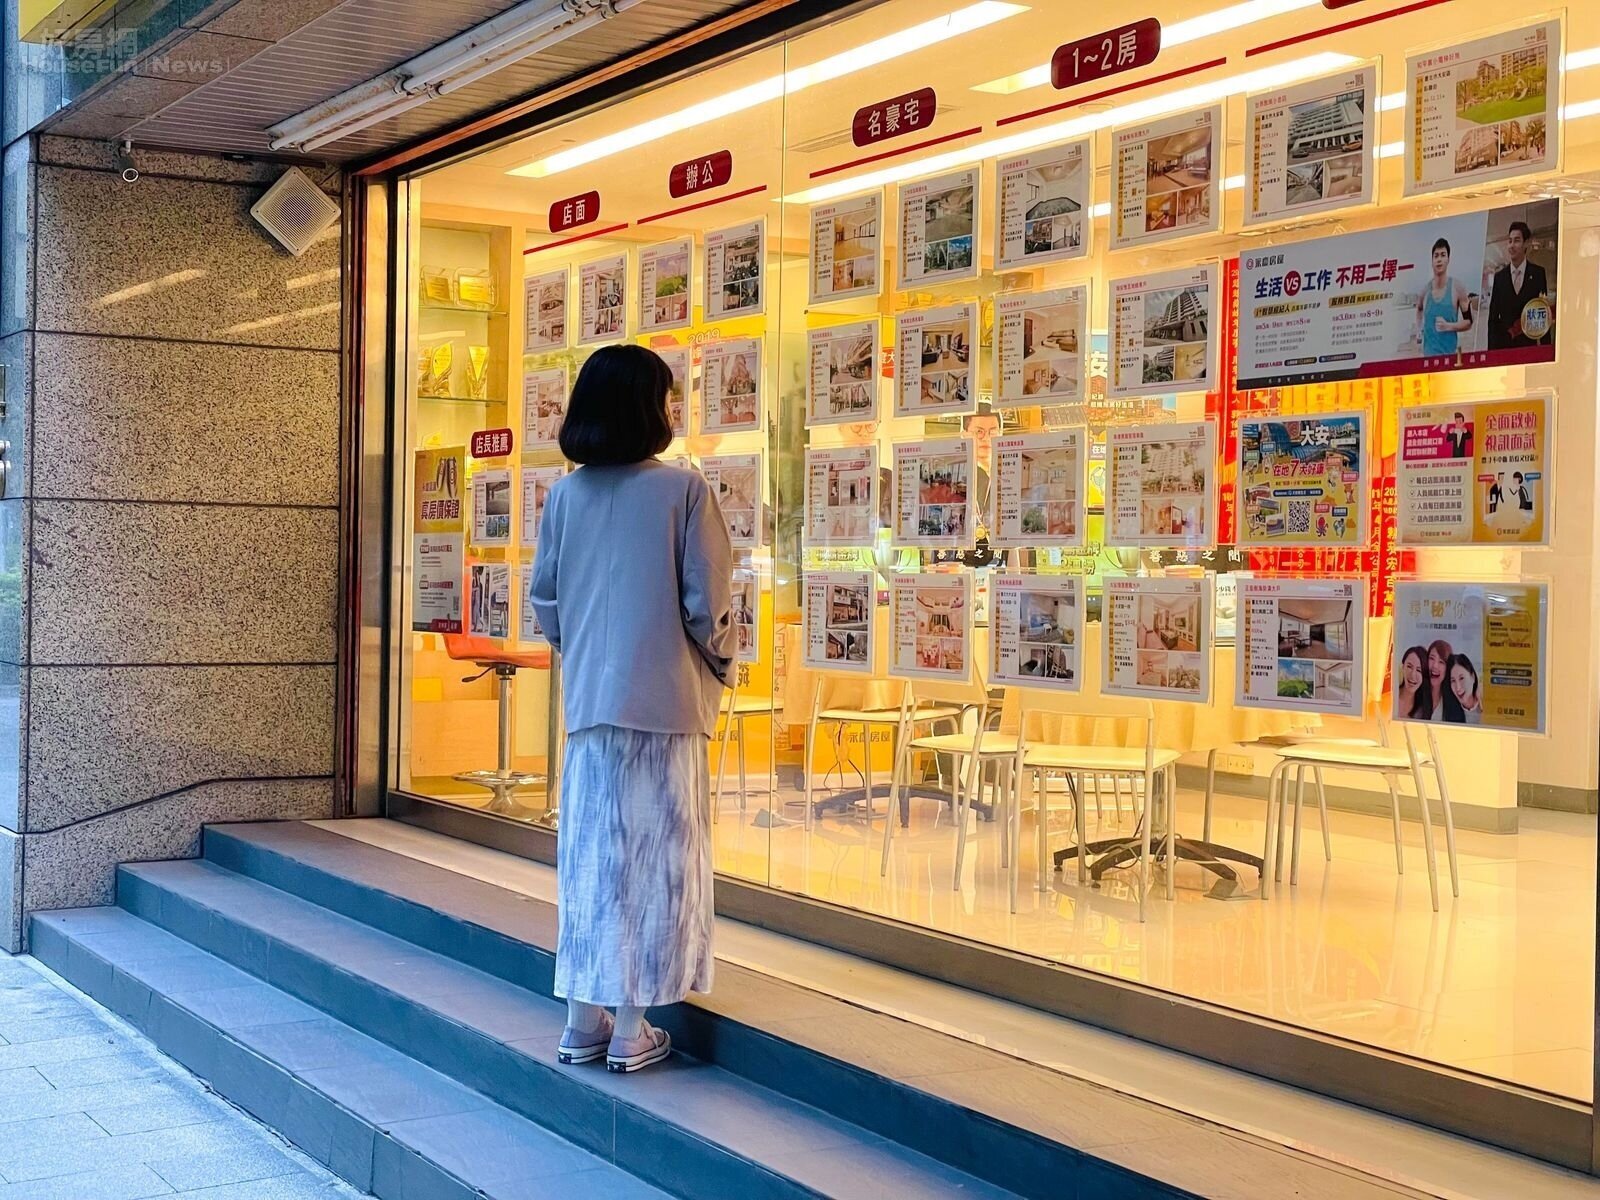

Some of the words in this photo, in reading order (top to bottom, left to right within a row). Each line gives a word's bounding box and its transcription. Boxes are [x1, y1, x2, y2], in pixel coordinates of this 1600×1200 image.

[1072, 29, 1137, 79] 1~2房
[868, 98, 920, 138] 名豪宅
[686, 160, 713, 190] 辦公
[562, 199, 586, 226] 店面
[1254, 275, 1283, 299] 生活
[1285, 276, 1300, 289] VS
[1301, 269, 1333, 292] 工作
[1335, 258, 1415, 289] 不用二擇一
[687, 328, 720, 345] 2019
[475, 432, 509, 454] 店長推薦
[1300, 424, 1329, 446] 大安
[1485, 432, 1537, 452] 視訊面試
[420, 500, 460, 520] 真房價保證
